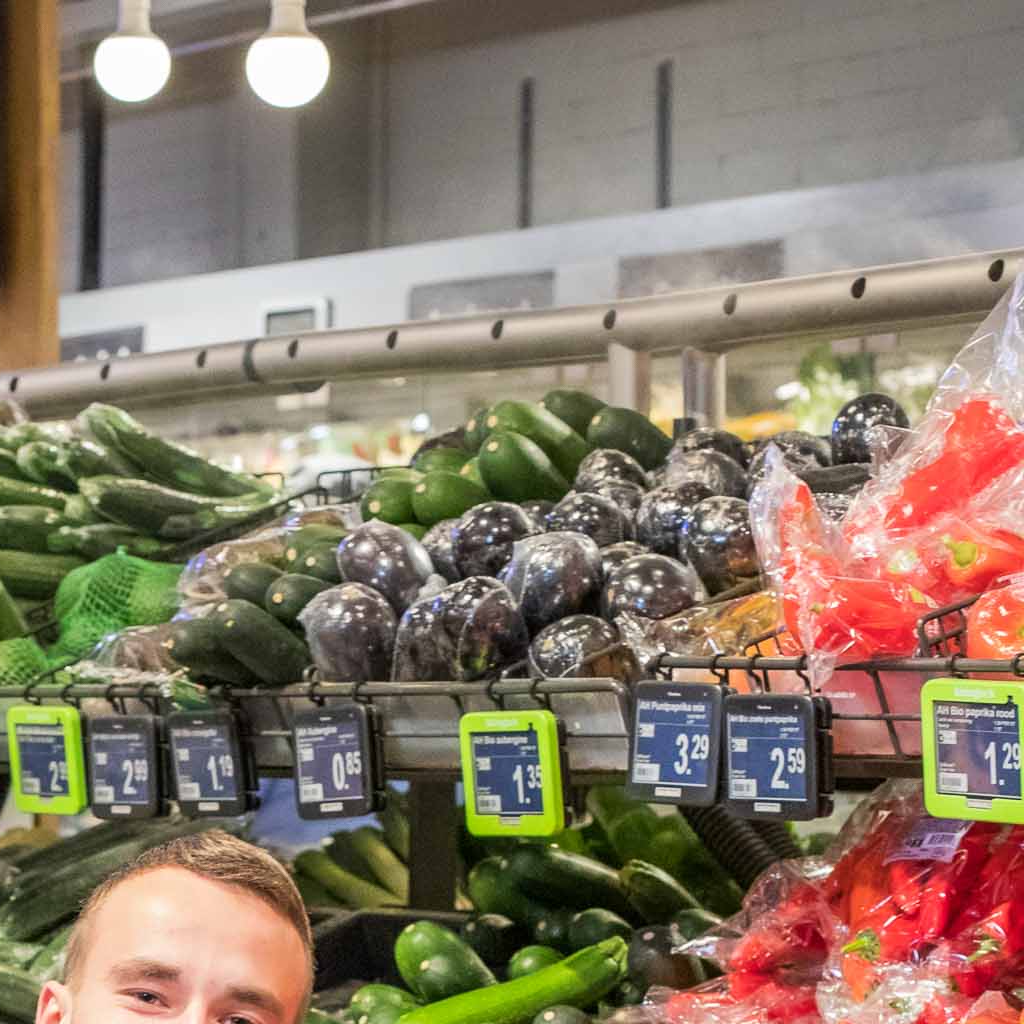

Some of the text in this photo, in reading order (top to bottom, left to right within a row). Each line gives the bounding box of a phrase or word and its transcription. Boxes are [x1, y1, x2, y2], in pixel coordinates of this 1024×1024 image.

[965, 707, 995, 719] paprika
[996, 708, 1015, 719] rood
[332, 751, 363, 791] 0.85
[674, 733, 710, 775] 3.29
[770, 747, 806, 789] 2.59
[512, 764, 543, 804] 1.35
